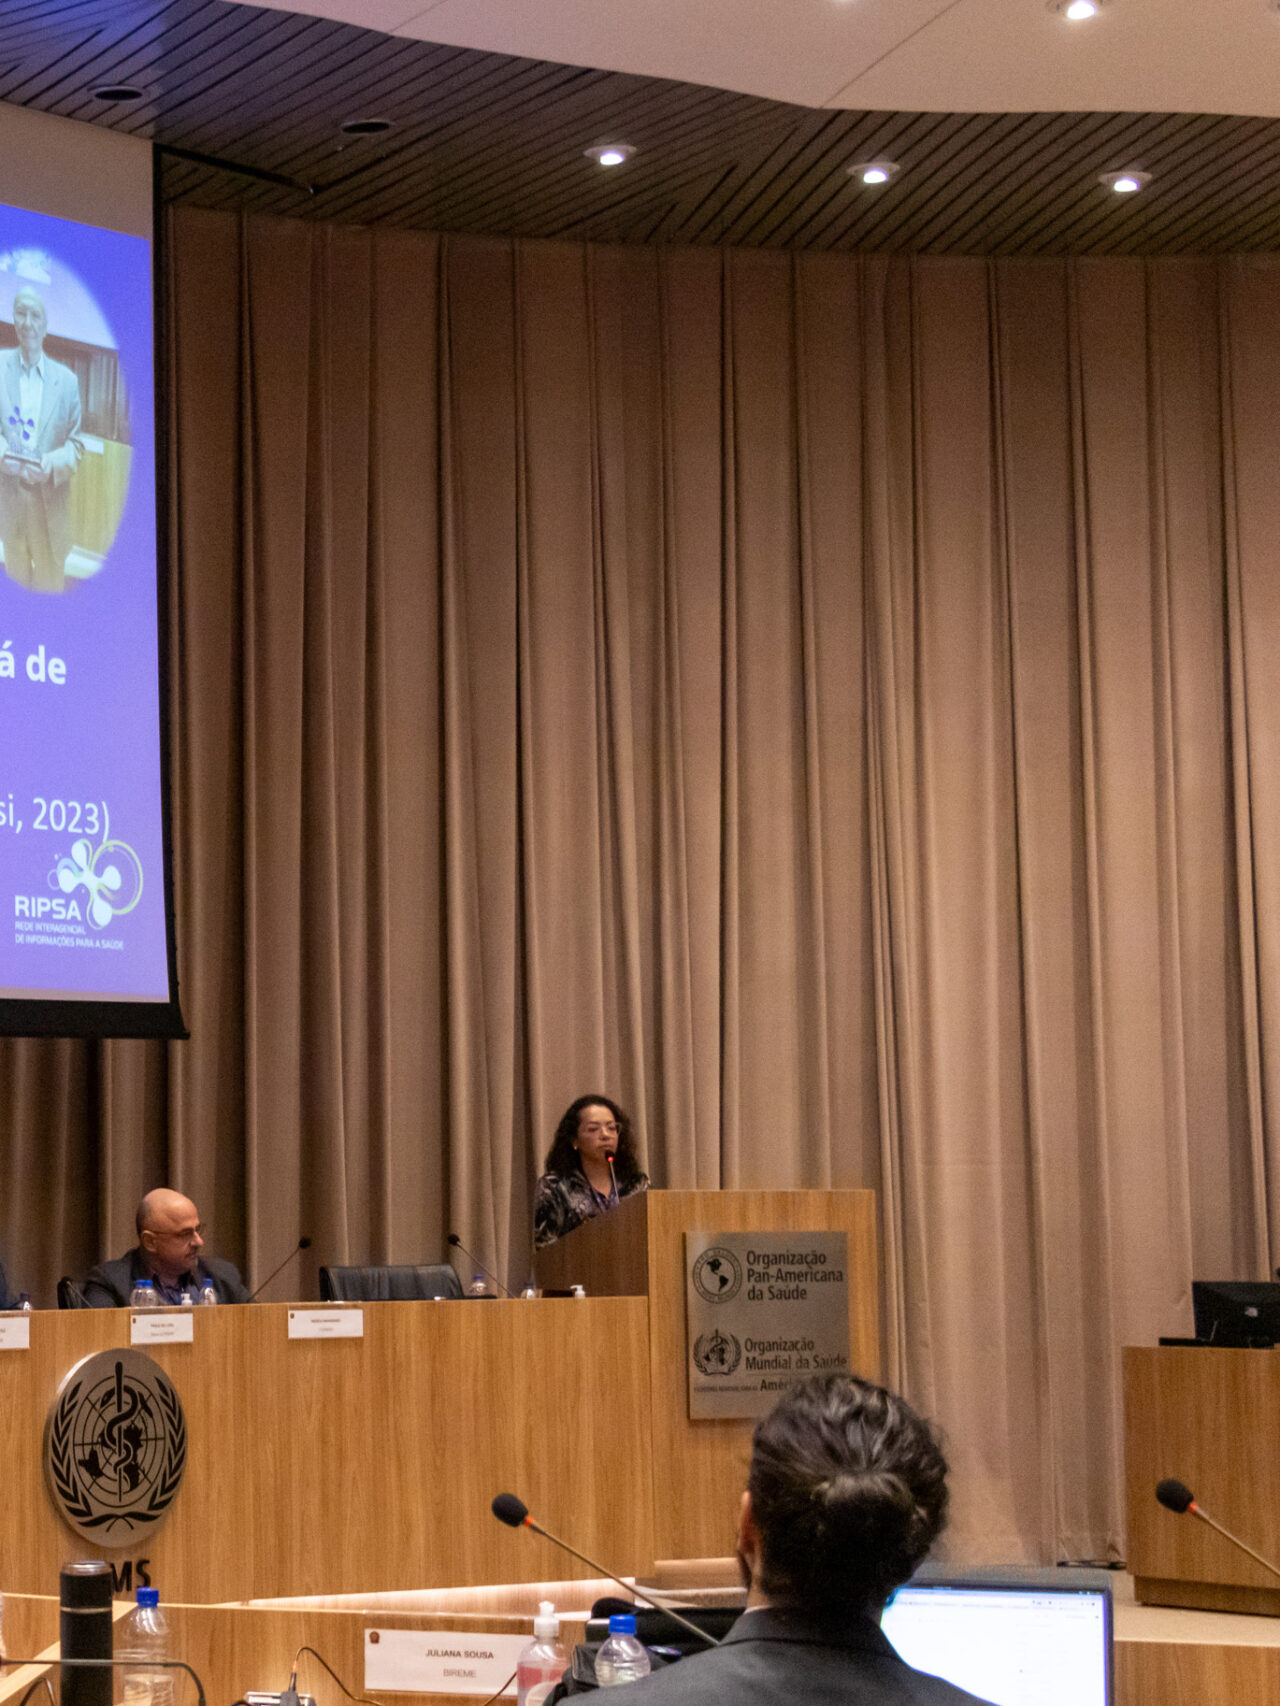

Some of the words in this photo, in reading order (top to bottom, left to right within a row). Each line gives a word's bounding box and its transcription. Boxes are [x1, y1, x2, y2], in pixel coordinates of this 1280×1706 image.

[26, 644, 67, 685] de
[33, 797, 110, 844] 2023)
[14, 895, 82, 921] RIPSA
[15, 921, 33, 931] REDE
[746, 1249, 826, 1269] Organização
[747, 1267, 843, 1283] Pan-Americana
[747, 1285, 763, 1300] da
[768, 1284, 807, 1300] Saúde
[744, 1336, 815, 1355] Organização
[745, 1354, 792, 1370] Mundial
[795, 1355, 810, 1369] da
[812, 1353, 848, 1369] Saúde
[110, 1559, 151, 1592] MS
[425, 1649, 461, 1657] JULIANA
[464, 1650, 494, 1659] SOUSA
[443, 1668, 477, 1678] BIREME
